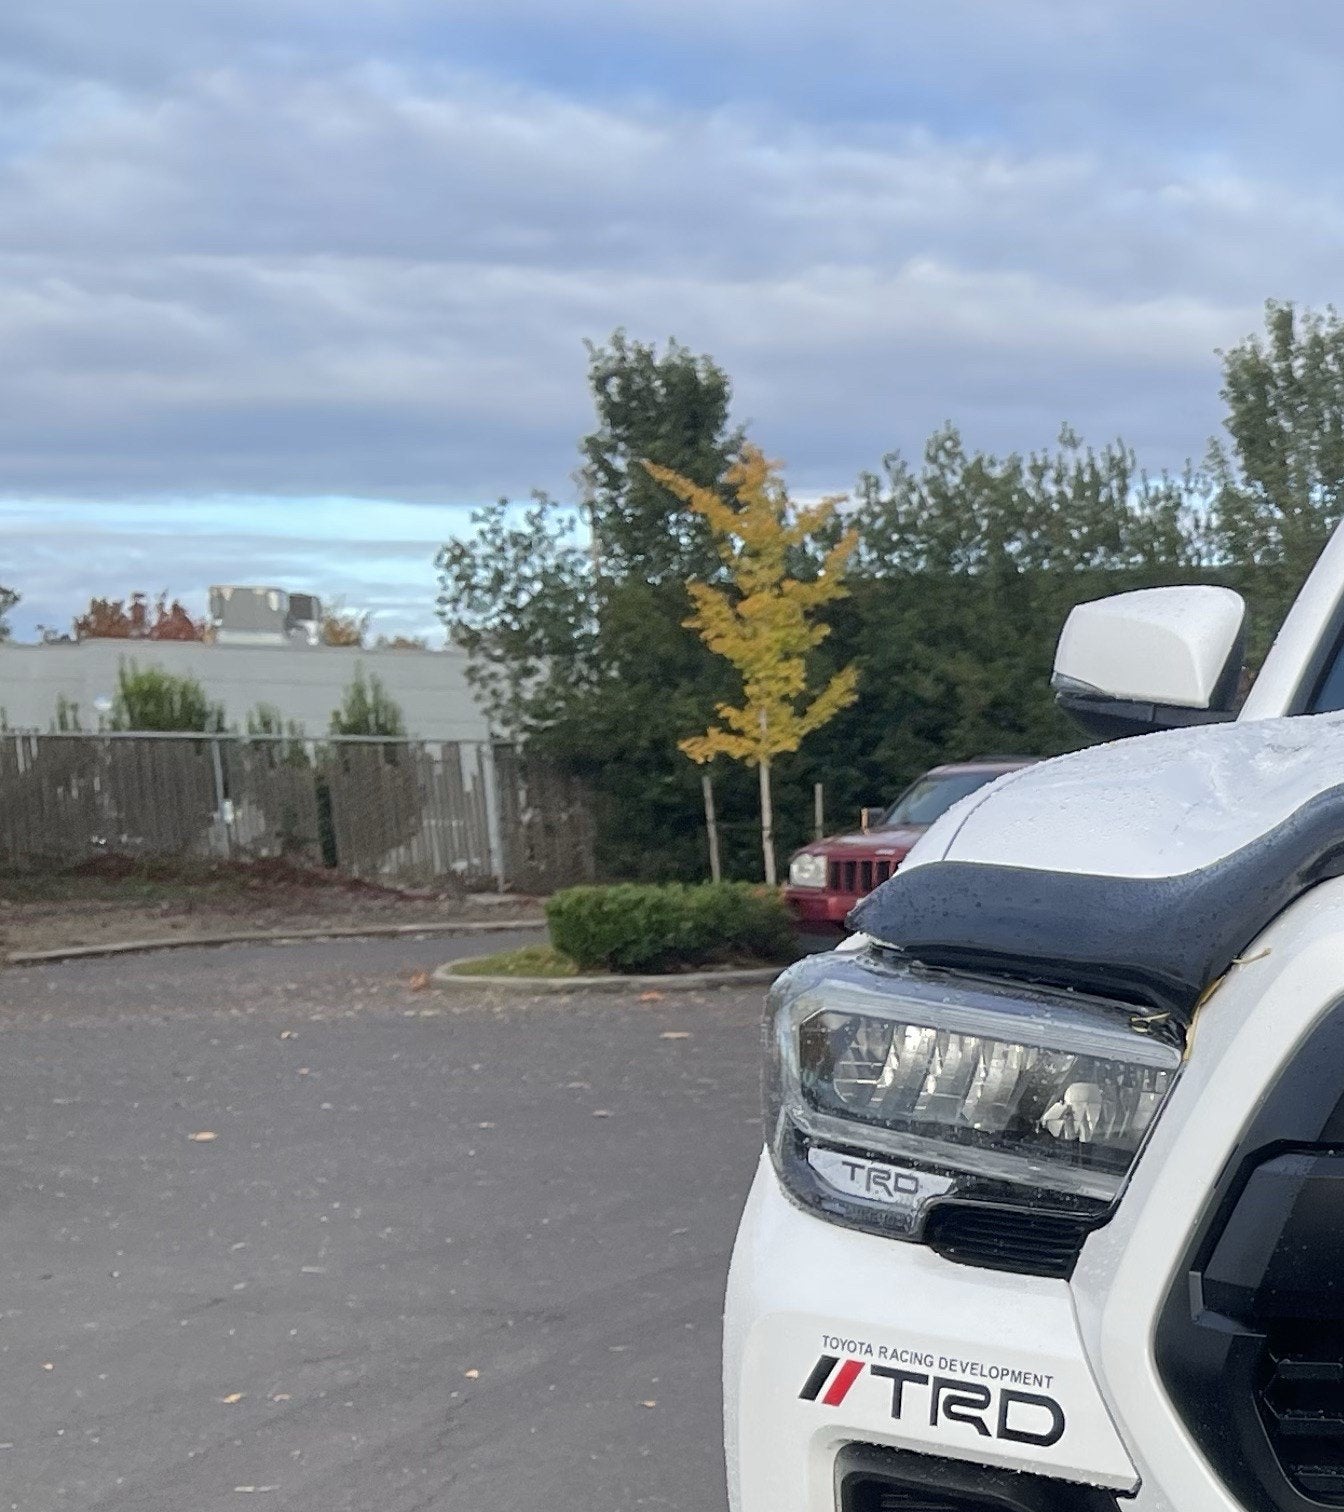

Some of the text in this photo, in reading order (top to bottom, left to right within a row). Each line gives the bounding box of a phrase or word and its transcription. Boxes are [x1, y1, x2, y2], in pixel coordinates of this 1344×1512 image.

[842, 1161, 919, 1197] TRD
[822, 1335, 1054, 1389] TOYOTA RACING DEVELOPMENT
[870, 1364, 1065, 1447] TRD
